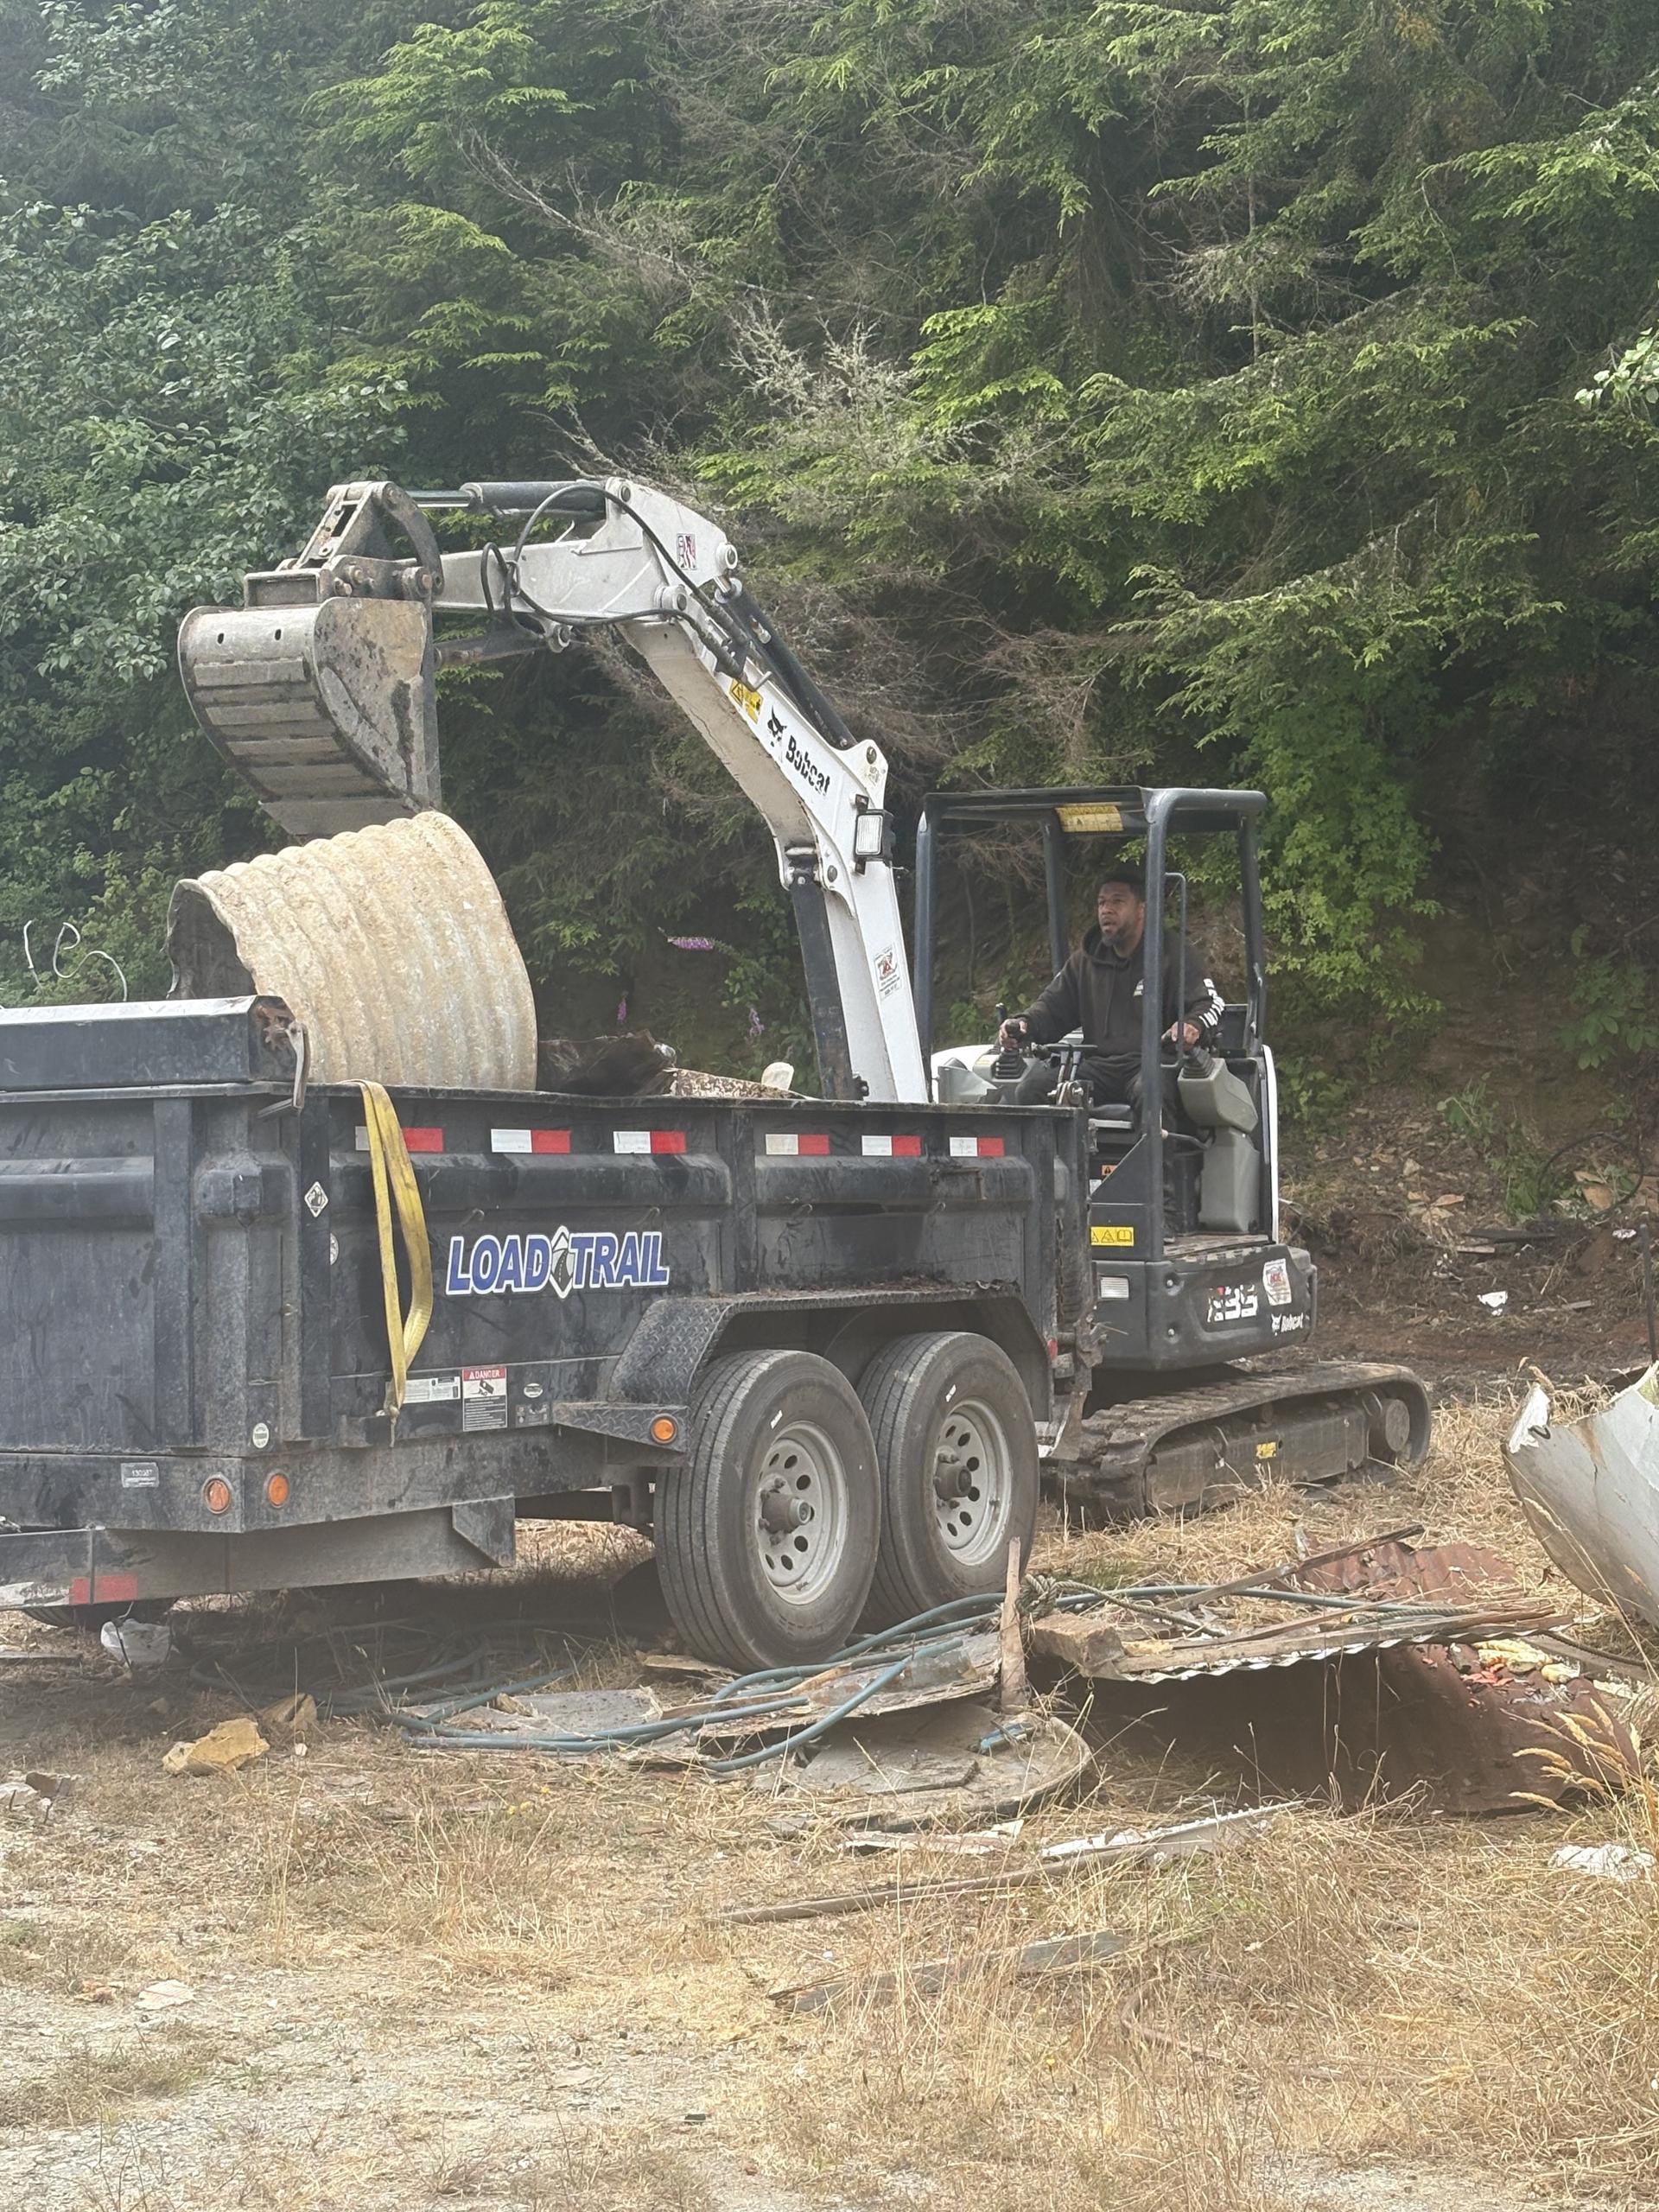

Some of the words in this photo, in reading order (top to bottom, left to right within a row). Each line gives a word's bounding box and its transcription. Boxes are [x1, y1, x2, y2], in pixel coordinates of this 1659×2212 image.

[785, 734, 830, 796] Bobcat
[446, 1234, 553, 1295] LOAD
[569, 1231, 670, 1289] TRAIL
[474, 1370, 500, 1380] DANGER
